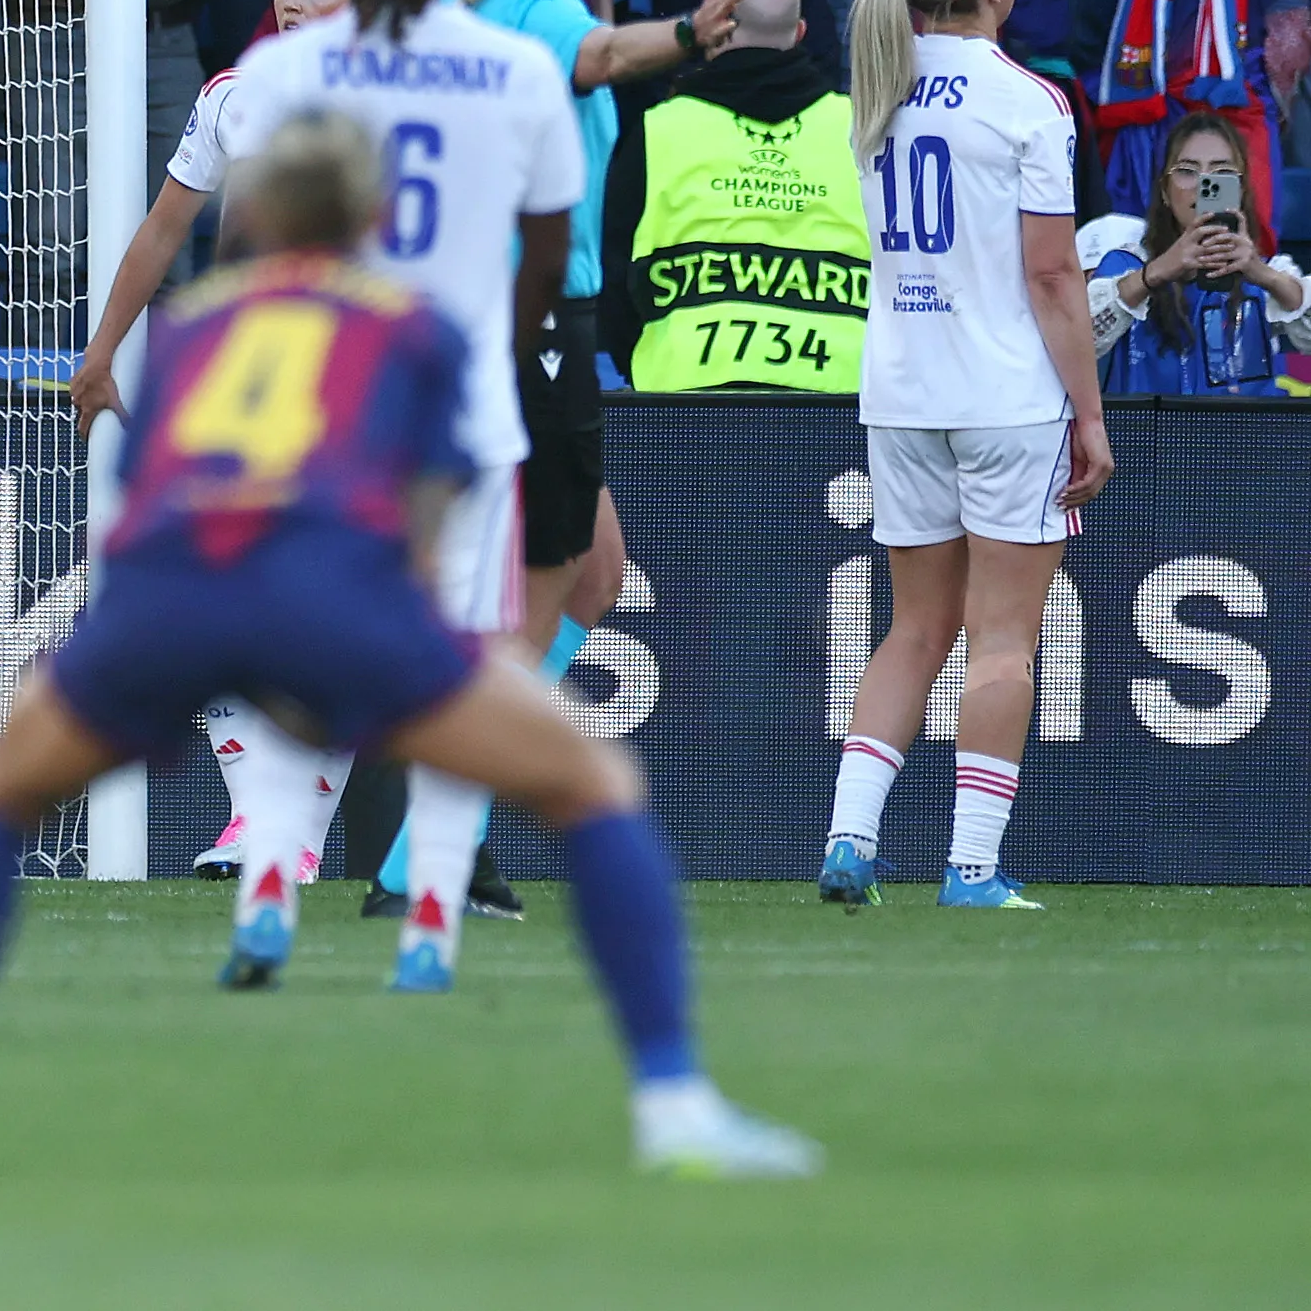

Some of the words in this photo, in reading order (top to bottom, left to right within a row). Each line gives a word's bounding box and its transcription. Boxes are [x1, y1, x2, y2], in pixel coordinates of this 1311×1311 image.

[899, 76, 969, 110] APS
[737, 164, 802, 180] women's
[751, 151, 788, 167] UEFA
[380, 120, 445, 261] 6
[710, 177, 828, 198] CHAMPIONS
[733, 194, 805, 213] LEAGUE
[874, 135, 956, 255] 10
[649, 249, 871, 311] STEWARD
[897, 281, 938, 300] Congo
[694, 319, 832, 372] 7734
[168, 296, 338, 481] 4
